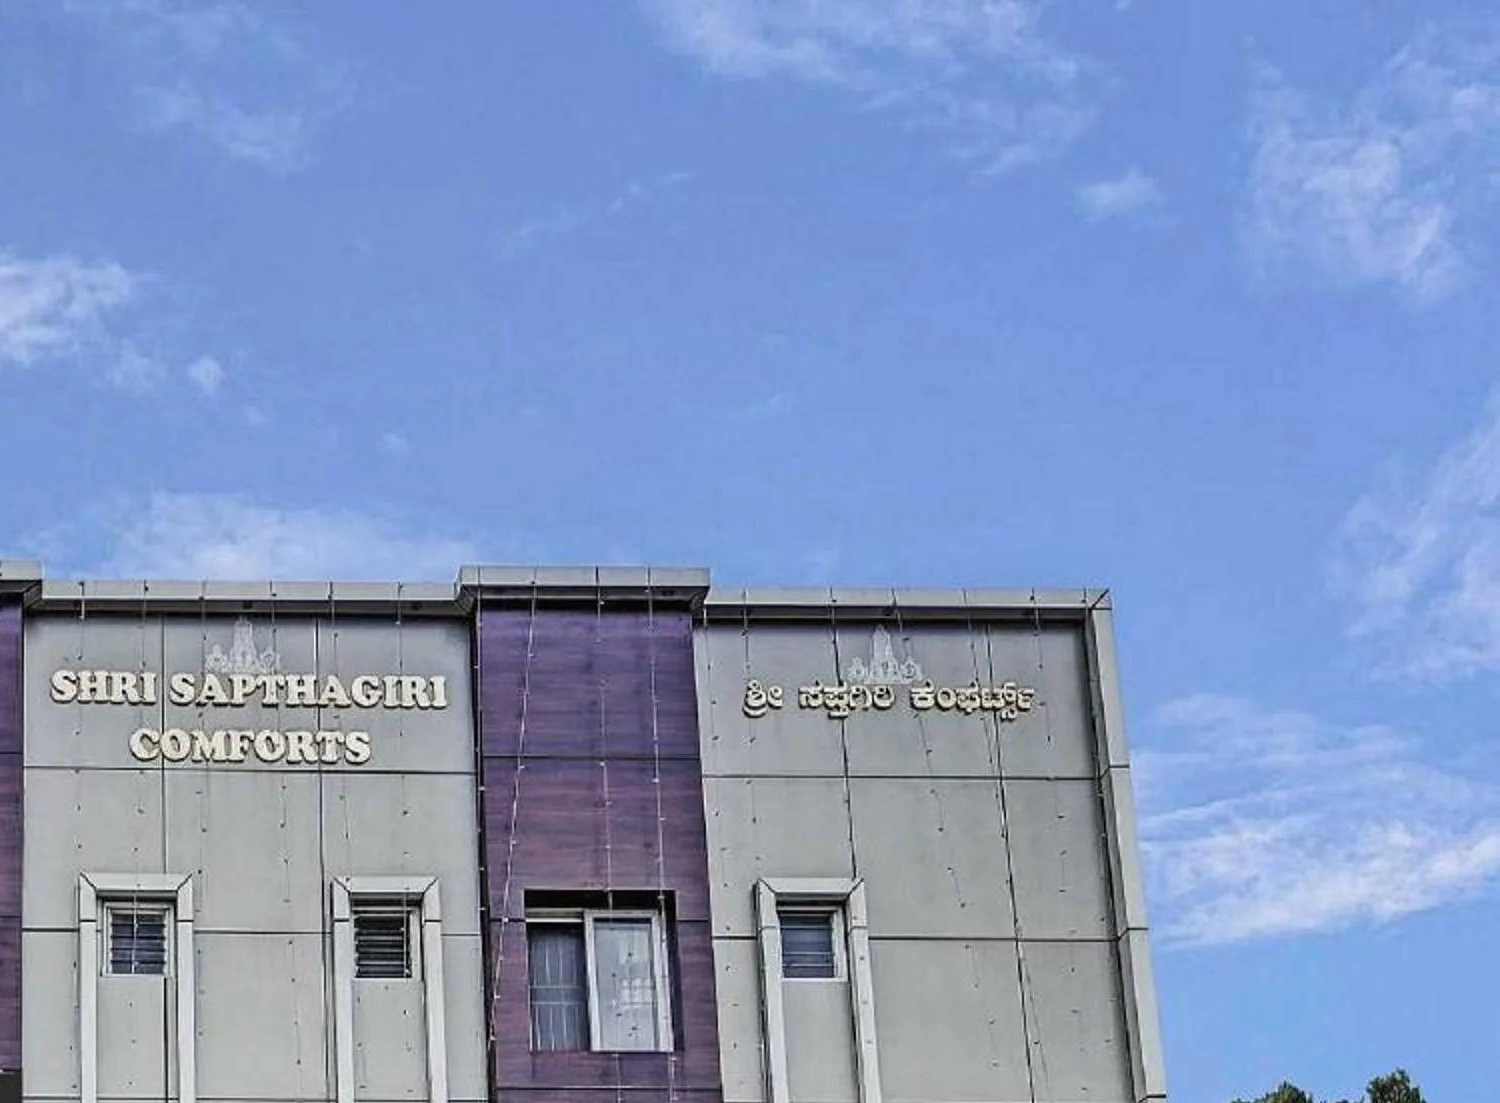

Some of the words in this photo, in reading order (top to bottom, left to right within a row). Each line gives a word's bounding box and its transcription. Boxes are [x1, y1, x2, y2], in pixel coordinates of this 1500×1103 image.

[50, 669, 157, 704] SHRI
[169, 671, 447, 708] SAPTHAGIRI
[743, 680, 783, 718] ಶ್ರೀ
[129, 728, 371, 764] COMFORTS
